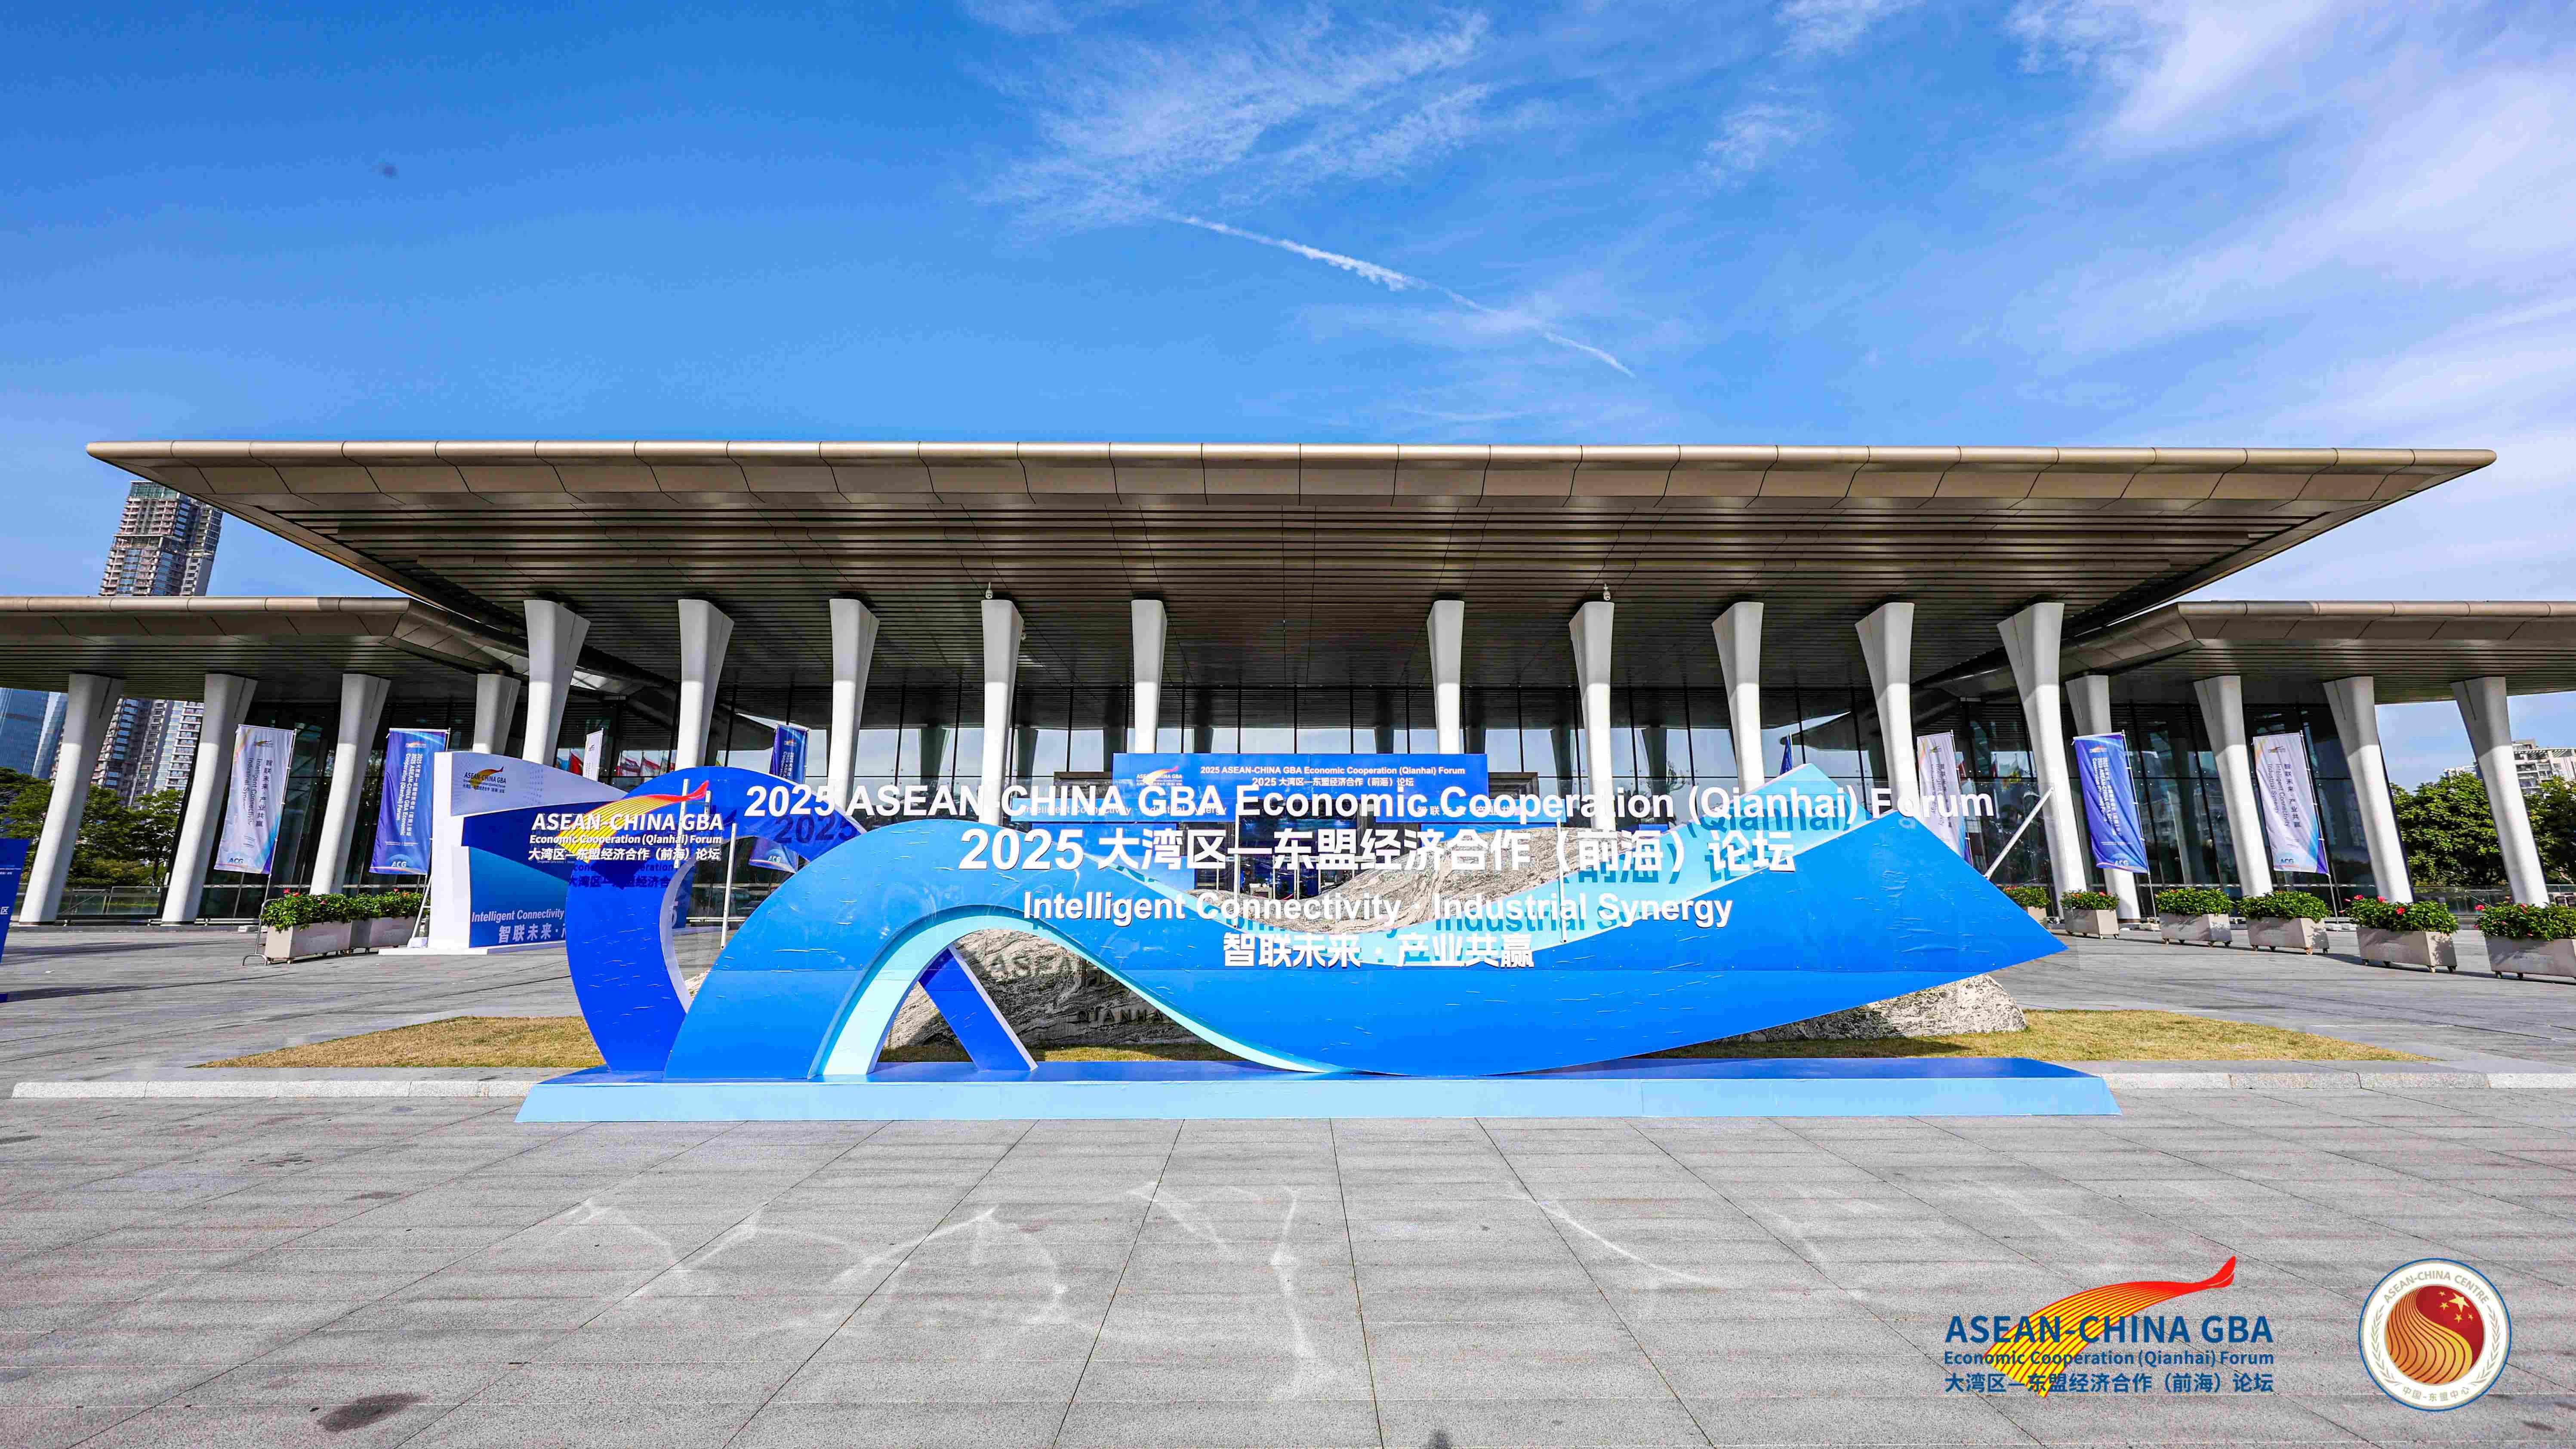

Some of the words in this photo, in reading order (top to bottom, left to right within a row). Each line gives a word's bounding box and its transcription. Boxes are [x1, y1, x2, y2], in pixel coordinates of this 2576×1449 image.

[1347, 766, 1397, 776] Cooperation
[1399, 766, 1436, 776] (Qianhai)
[1252, 778, 1276, 787] 2025
[744, 784, 835, 817] 2025
[1138, 784, 1226, 817] GBA
[1236, 784, 1428, 817] Economic
[1440, 786, 1673, 824] Cooperation
[1689, 785, 1857, 826] (Qianhai)
[1871, 788, 1994, 817] Forum
[531, 813, 675, 831] ASEAN-CHINA
[682, 813, 723, 831] GBA
[530, 834, 578, 844] Economic
[580, 834, 640, 845] Cooperation
[642, 834, 688, 846] (Qianhai)
[690, 835, 722, 844] Forum
[958, 828, 1083, 871] 2025
[471, 910, 515, 923] Intelligent
[517, 908, 564, 920] Connectivity
[1024, 892, 1185, 926] Intelligent
[1196, 892, 1402, 926] Connectivity
[1434, 893, 1586, 921] Industrial
[1598, 892, 1733, 928] Synergy
